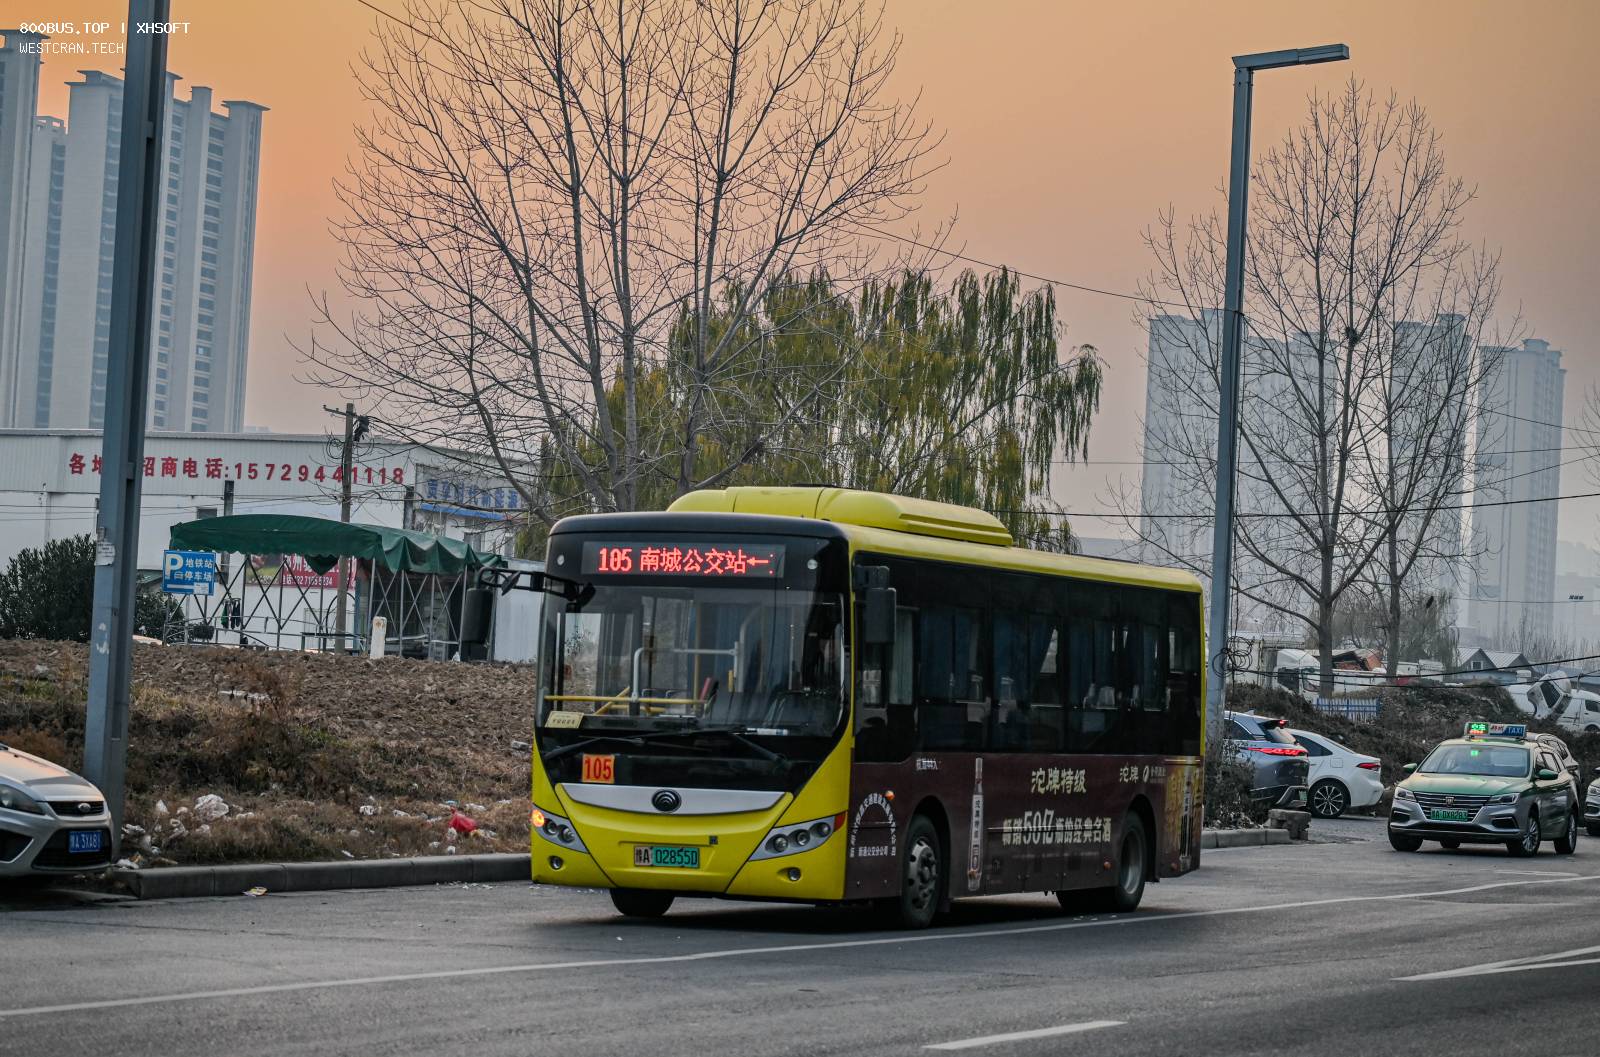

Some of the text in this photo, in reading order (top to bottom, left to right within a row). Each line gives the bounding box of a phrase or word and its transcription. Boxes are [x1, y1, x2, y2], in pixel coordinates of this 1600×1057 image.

[165, 553, 184, 580] P
[185, 557, 213, 569] 地铁站
[598, 546, 747, 575] 105 南城公交站
[184, 570, 212, 582] 停车场
[1508, 726, 1523, 735] TAXI
[583, 756, 612, 781] 105
[1030, 767, 1087, 795] 沱牌特级
